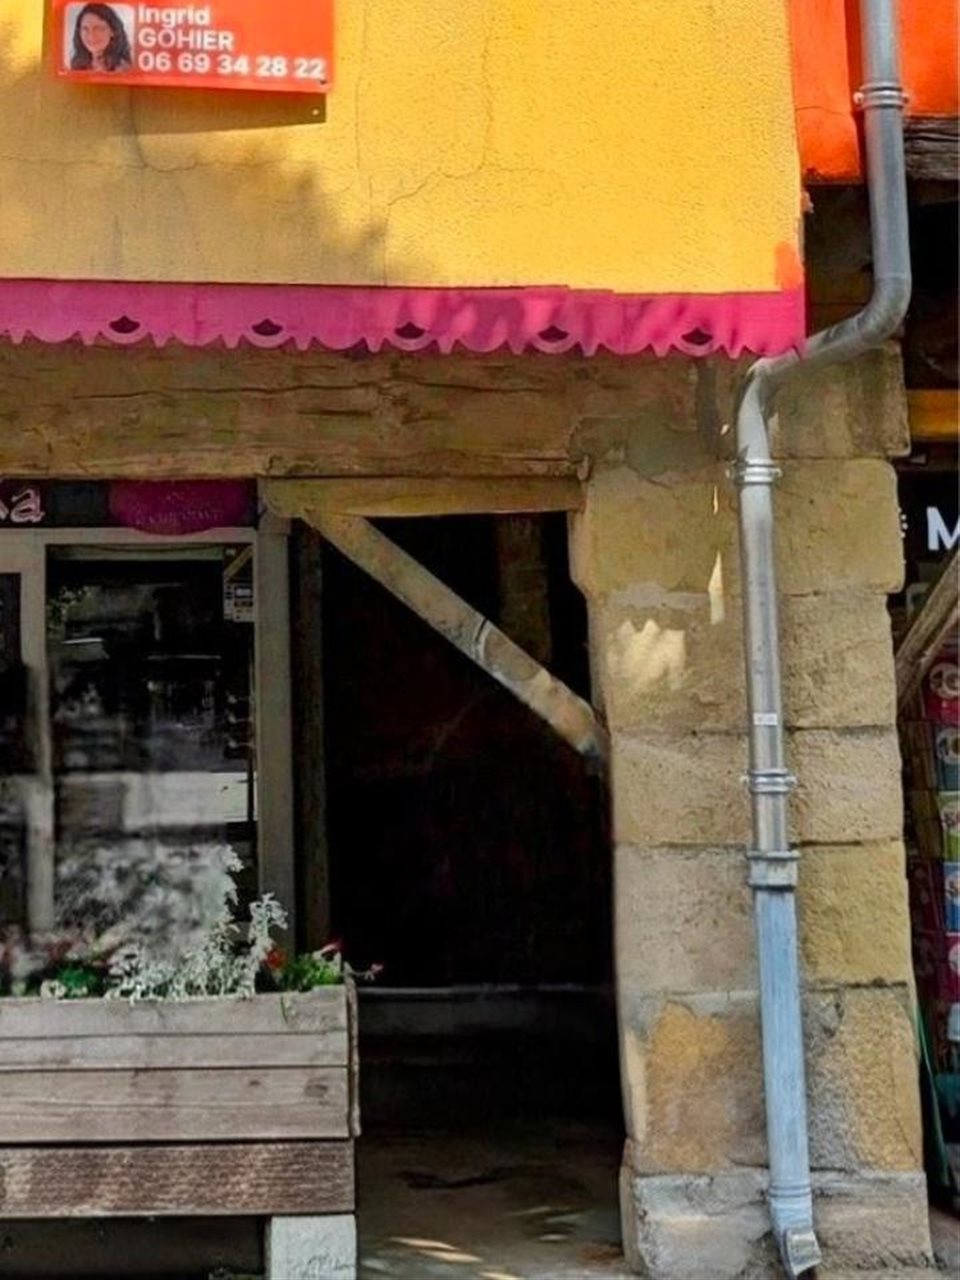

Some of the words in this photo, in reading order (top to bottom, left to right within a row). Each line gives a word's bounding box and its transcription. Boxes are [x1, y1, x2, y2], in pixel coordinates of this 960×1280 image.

[138, 5, 211, 27] Ingrid
[138, 28, 235, 51] GOHIER
[138, 52, 171, 71] 06
[178, 53, 211, 73] 69
[217, 54, 249, 75] 34
[255, 56, 288, 76] 28
[293, 58, 326, 80] 22
